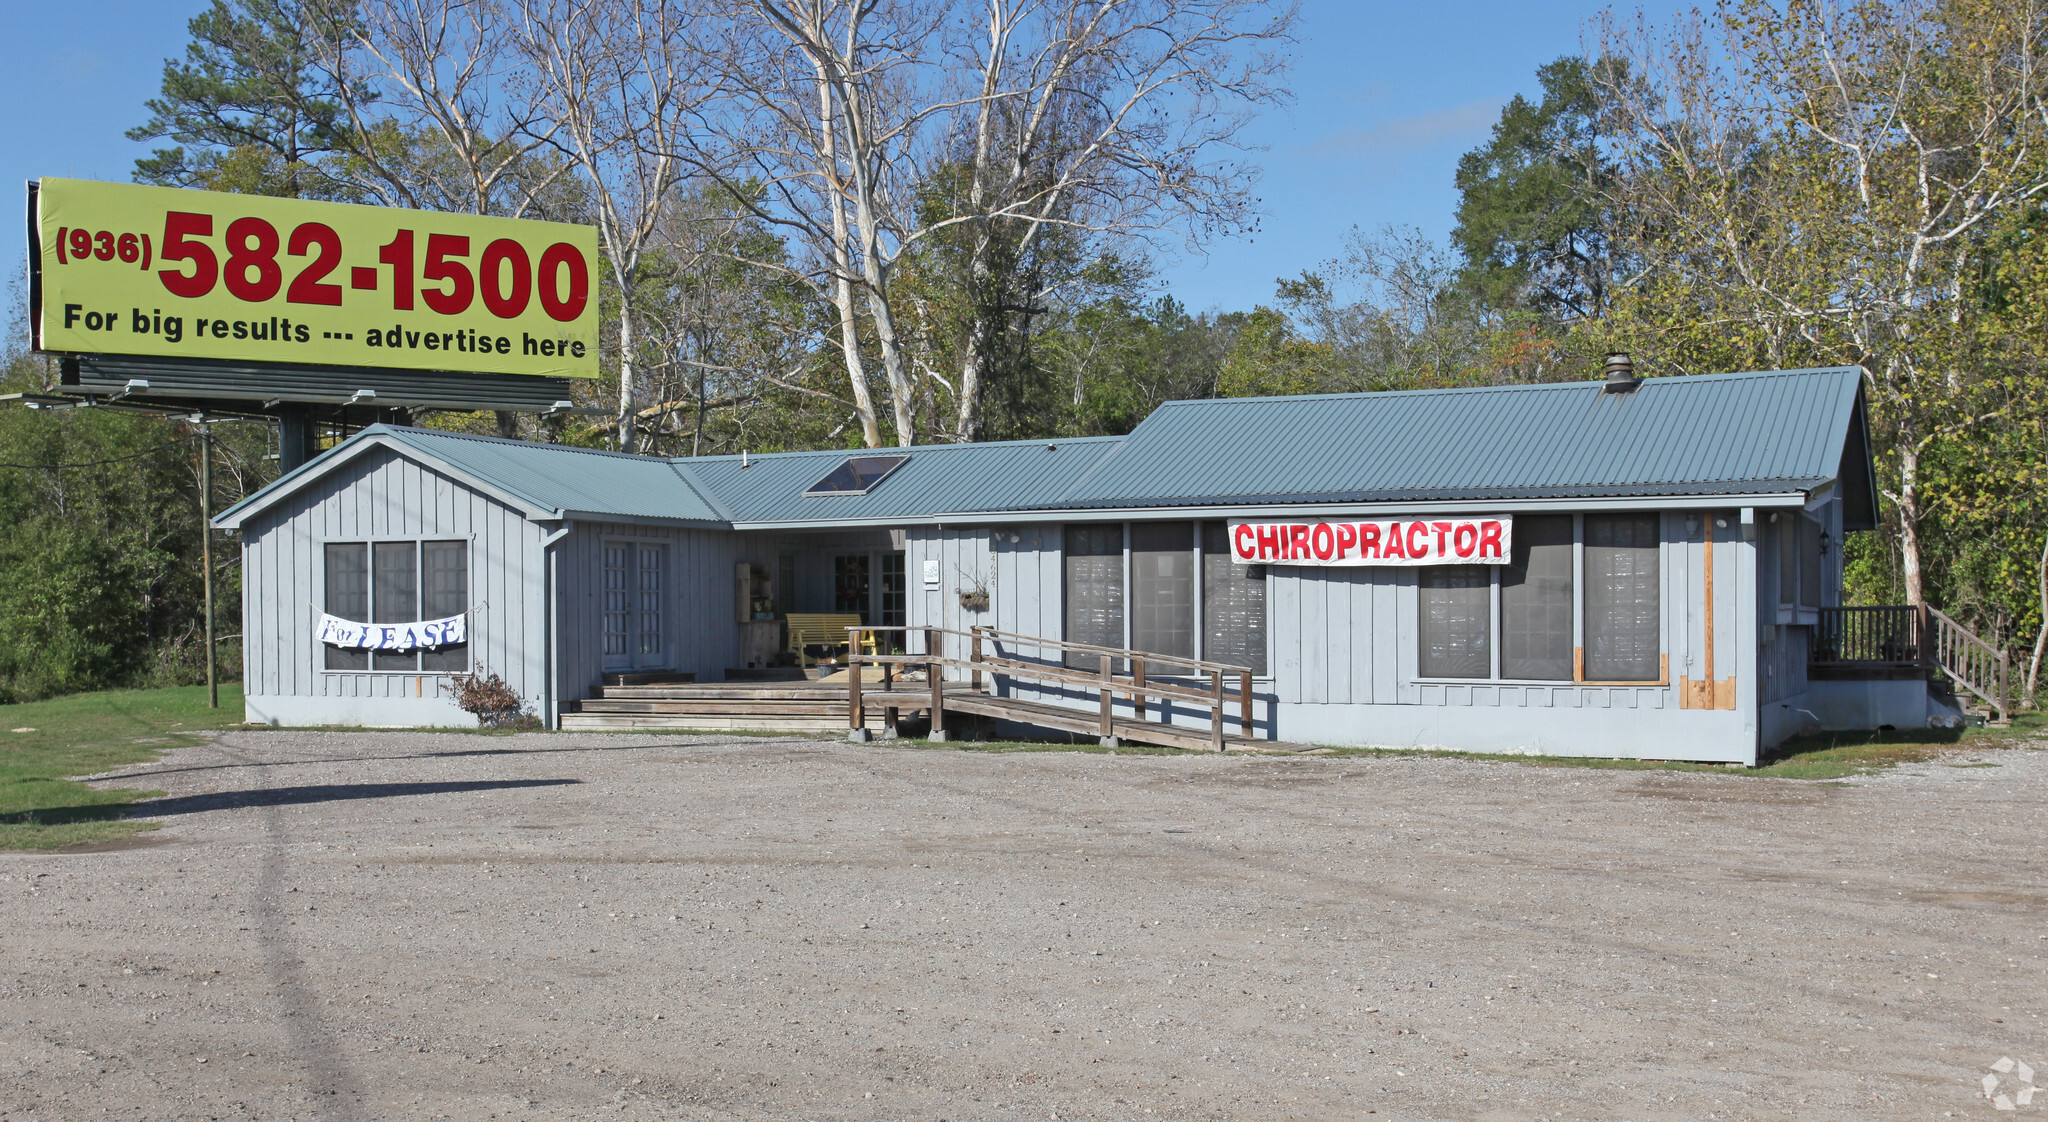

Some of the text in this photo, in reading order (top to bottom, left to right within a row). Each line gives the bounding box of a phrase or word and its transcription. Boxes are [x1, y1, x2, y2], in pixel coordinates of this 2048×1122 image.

[56, 210, 589, 323] (936) 582-1500
[64, 303, 118, 332] For
[132, 308, 183, 343] big
[196, 316, 311, 343] results
[366, 324, 512, 355] advertise
[522, 332, 586, 359] here
[1234, 520, 1502, 561] CHIROPRACTOR
[321, 619, 460, 649] For LEASE
